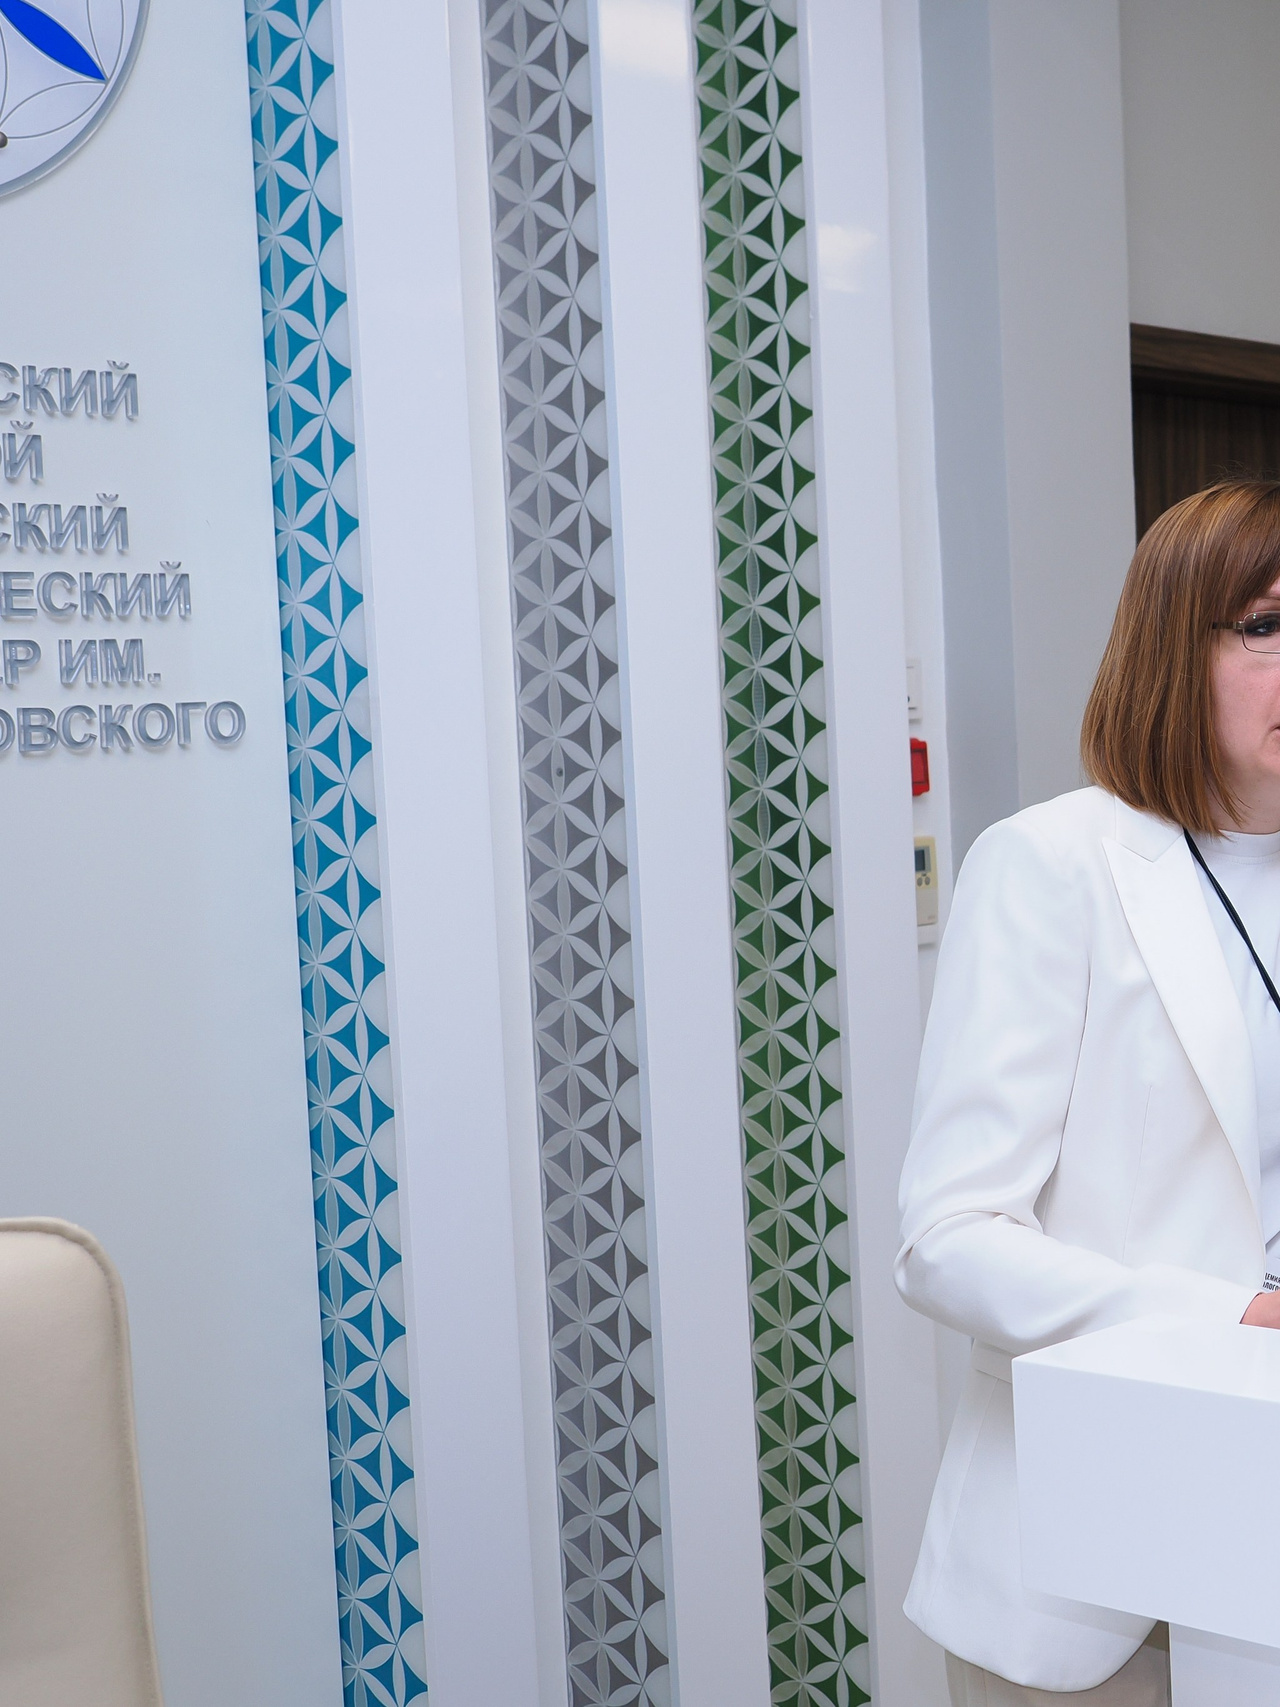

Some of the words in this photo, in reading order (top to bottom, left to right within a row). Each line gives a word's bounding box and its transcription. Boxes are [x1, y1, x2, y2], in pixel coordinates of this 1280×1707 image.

[0, 420, 44, 481] Й
[0, 492, 130, 551] КИЙ
[0, 560, 192, 618] ЕСКИЙ
[0, 638, 41, 686] Р
[58, 638, 161, 685] ИМ.
